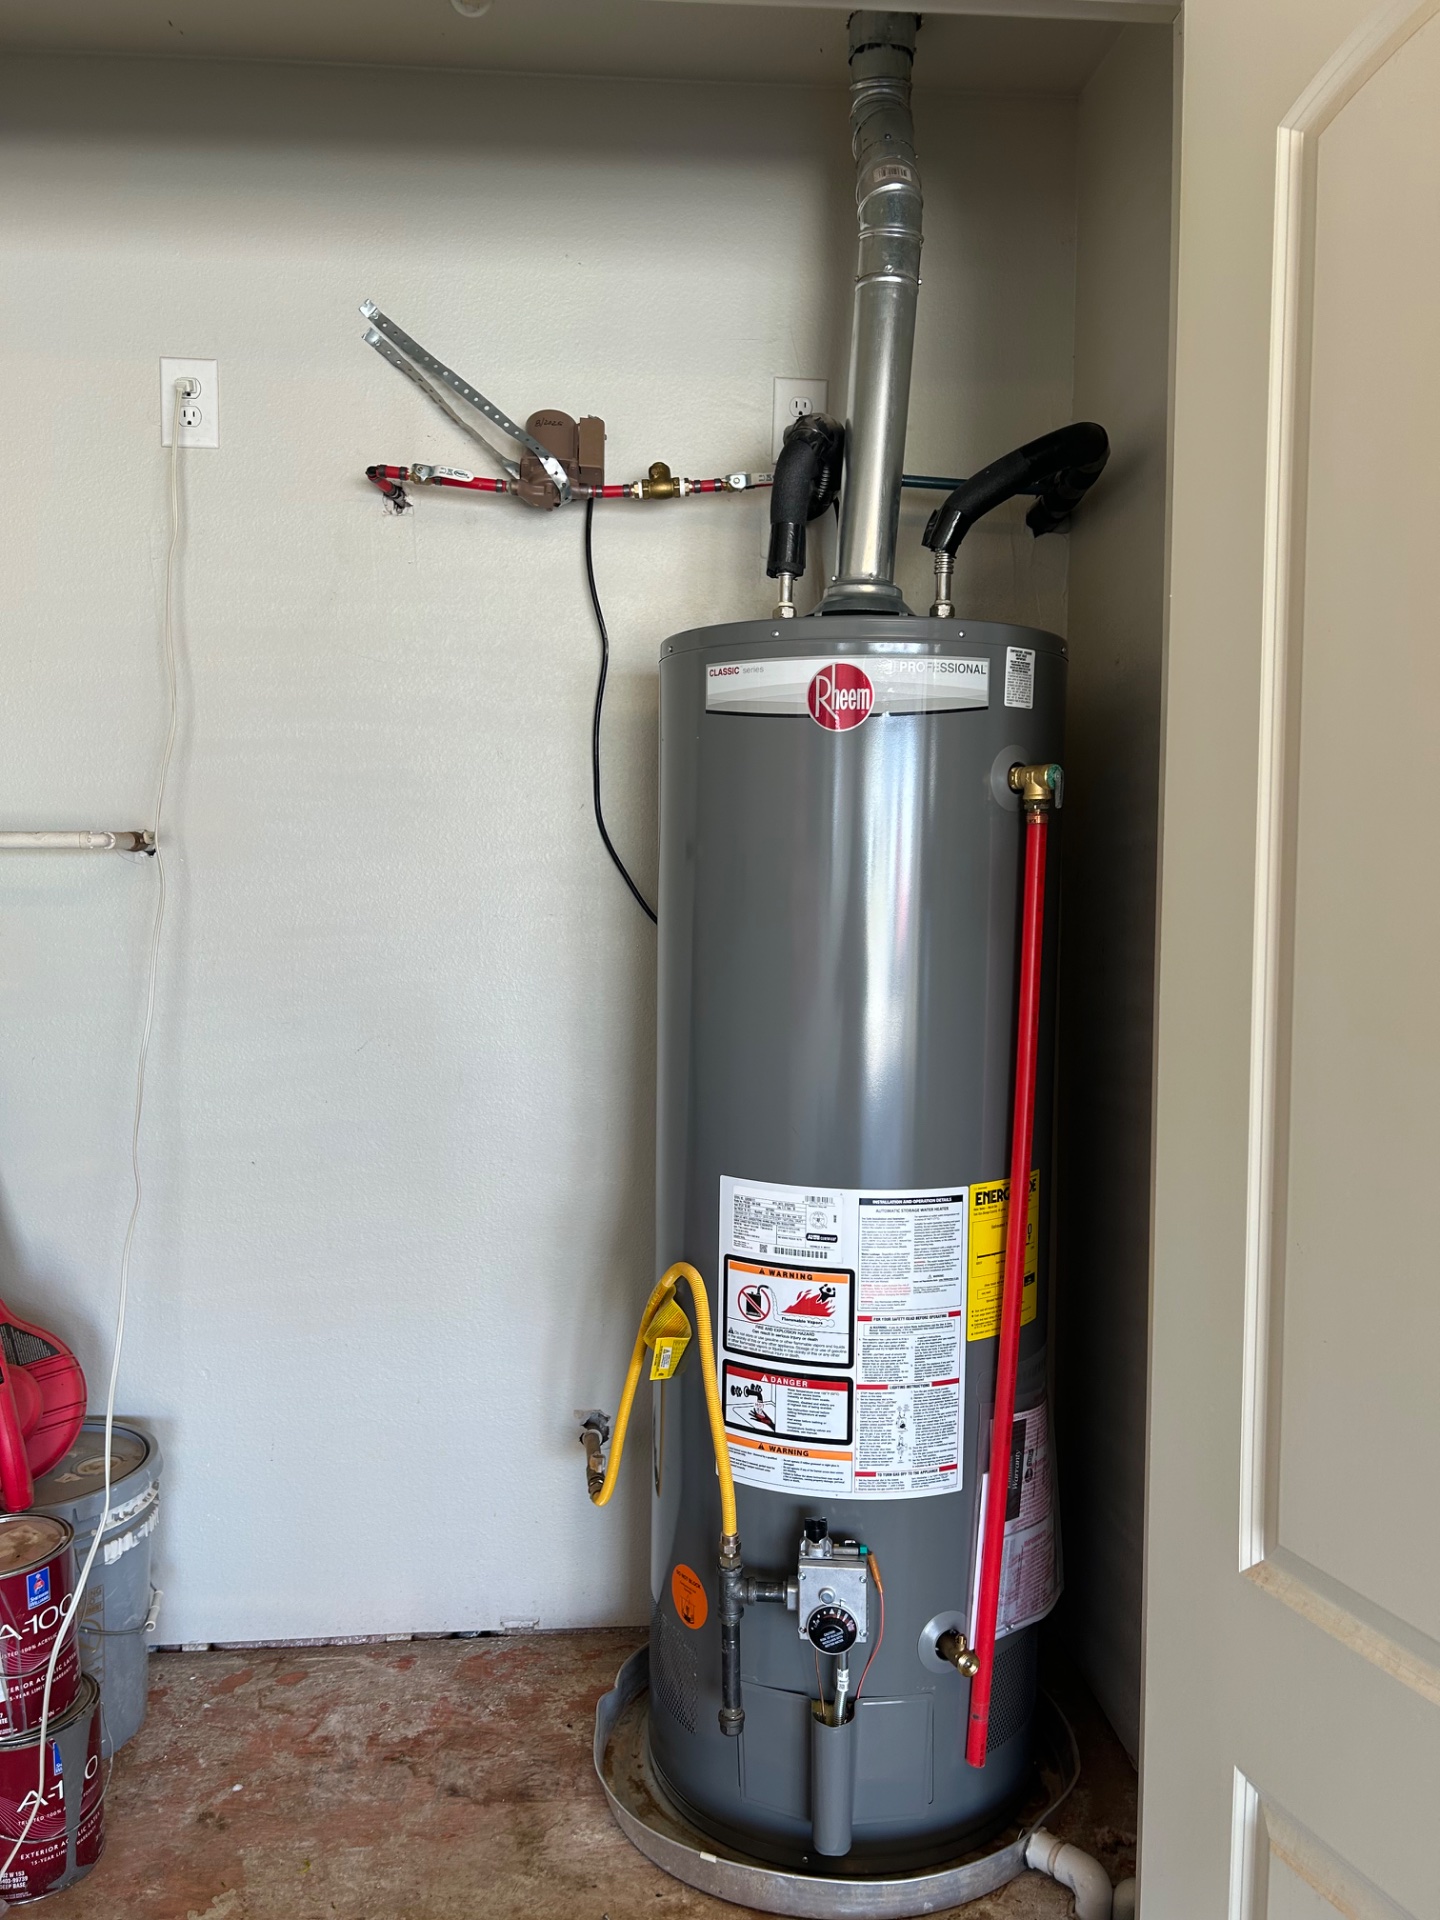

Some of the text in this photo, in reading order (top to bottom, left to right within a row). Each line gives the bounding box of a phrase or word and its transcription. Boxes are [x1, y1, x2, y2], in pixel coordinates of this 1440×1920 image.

[709, 666, 764, 677] CLASSIC series
[899, 662, 986, 675] PROFESSIONAL
[814, 662, 870, 719] Rheem
[768, 1269, 813, 1280] WARNING
[770, 1377, 808, 1388] DANGER
[768, 1446, 809, 1457] WARNING
[1012, 1448, 1022, 1490] Warranty
[0, 1593, 74, 1640] A-100
[36, 1664, 62, 1684] ACLIC
[31, 1684, 46, 1694] LIMIT
[39, 1710, 55, 1722] SIN
[16, 1754, 98, 1813] A-10
[18, 1816, 44, 1826] TRUTED
[20, 1844, 58, 1860] EXTERIOR
[61, 1826, 86, 1846] ACLIC
[31, 1854, 55, 1866] 15-YEAR
